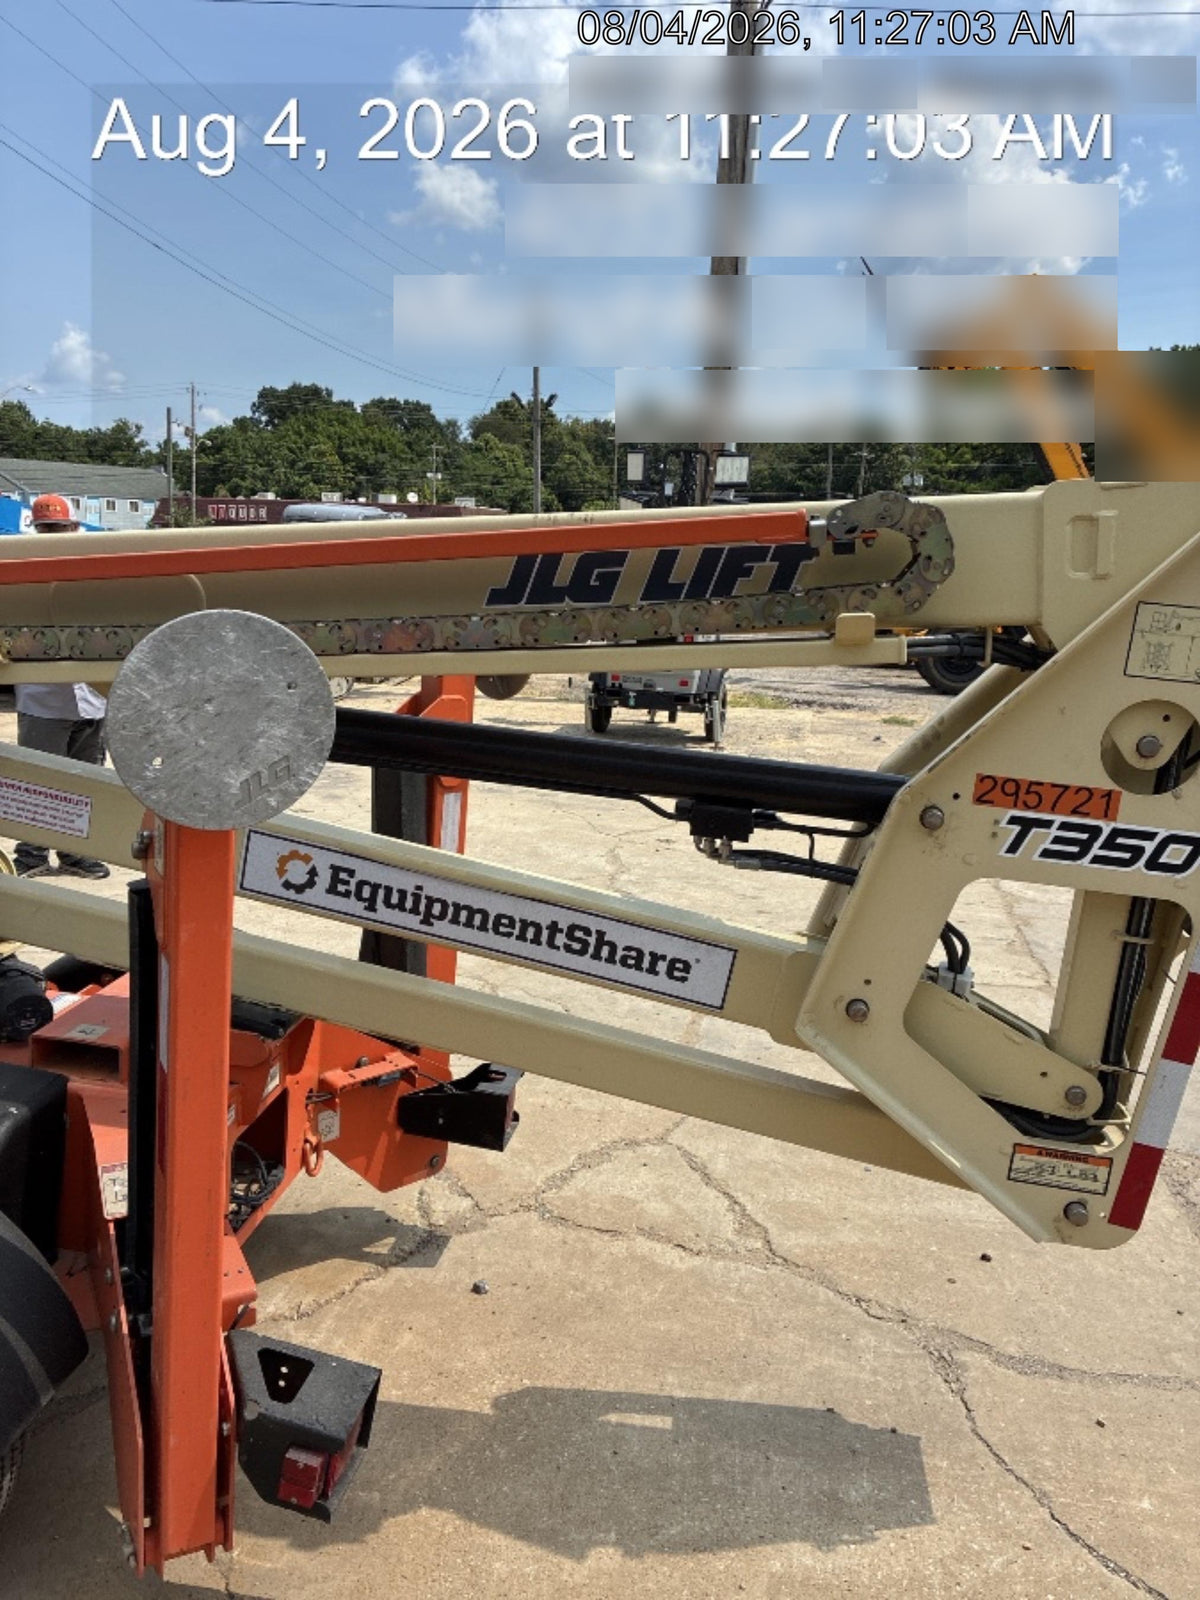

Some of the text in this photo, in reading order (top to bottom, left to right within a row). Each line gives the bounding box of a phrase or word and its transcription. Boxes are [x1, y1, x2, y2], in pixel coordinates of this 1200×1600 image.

[484, 543, 820, 607] JLG LIFT
[974, 774, 1115, 820] 295721
[1001, 812, 1200, 877] T350
[325, 863, 692, 984] EquipmentShare
